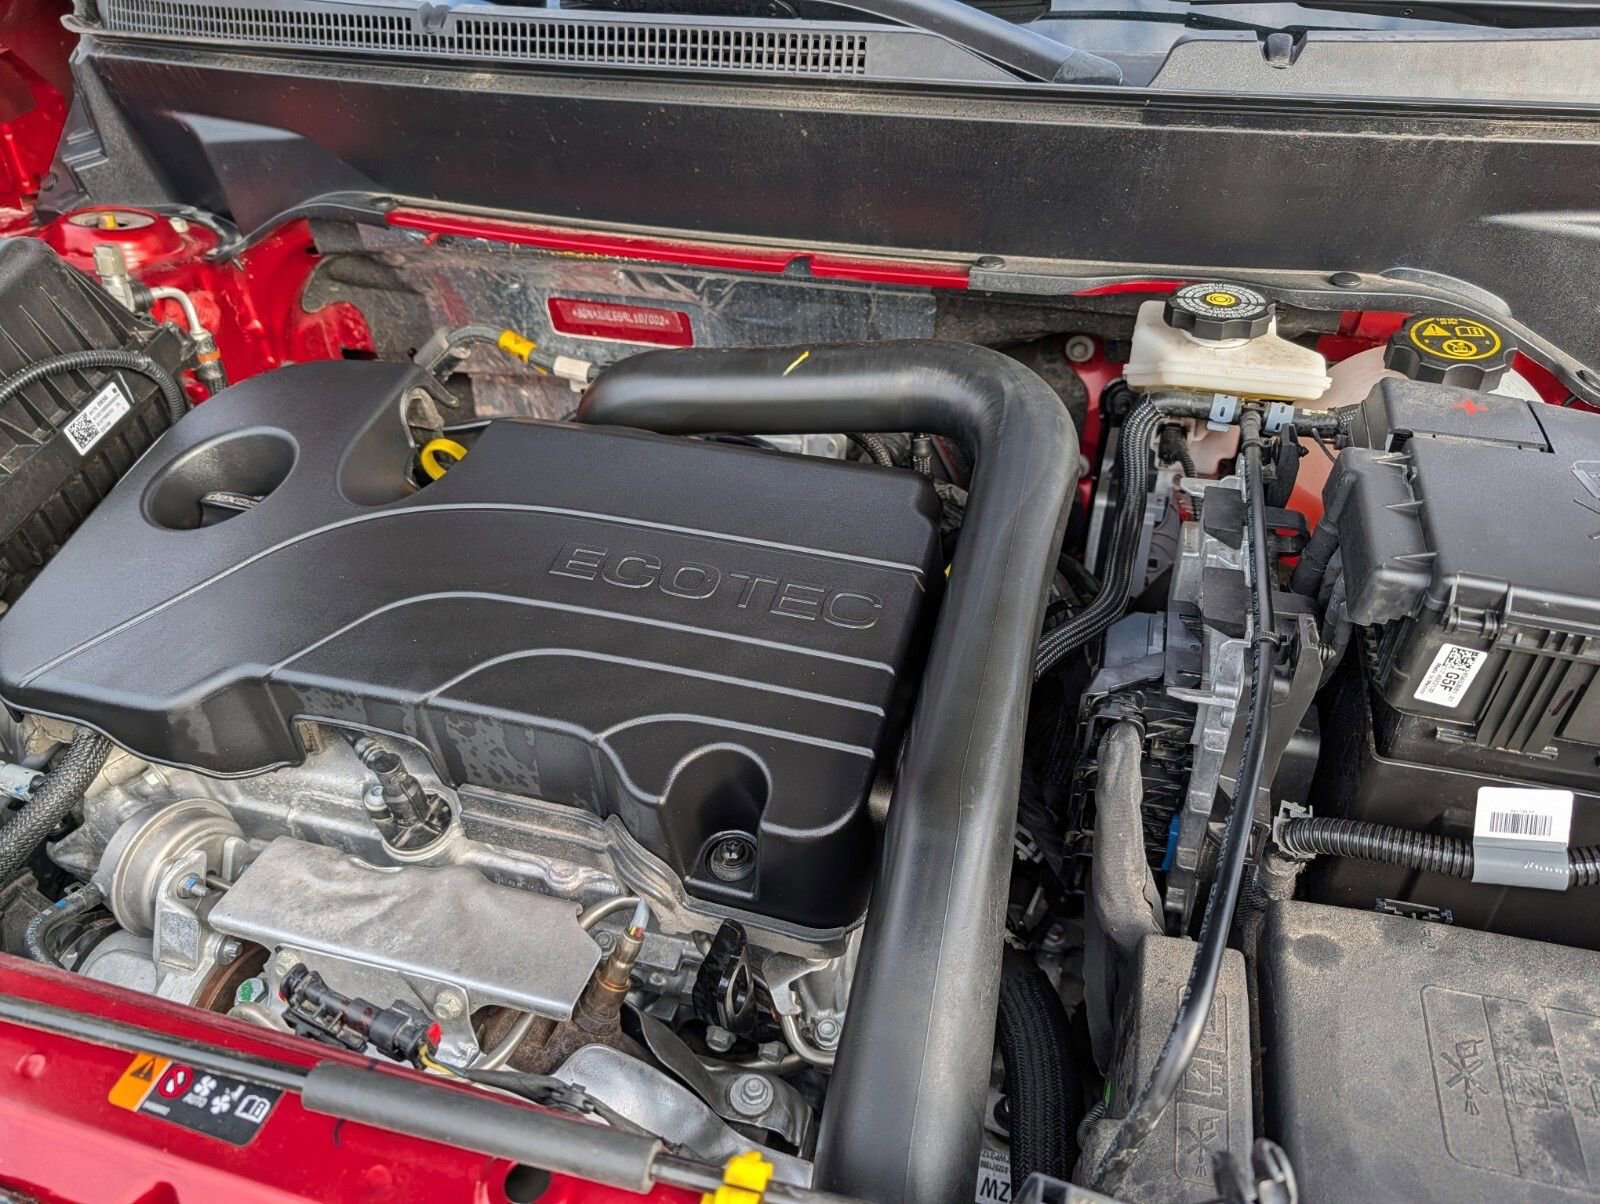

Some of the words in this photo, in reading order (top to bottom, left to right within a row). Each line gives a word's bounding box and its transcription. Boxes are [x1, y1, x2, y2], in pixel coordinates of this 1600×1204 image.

[549, 542, 883, 630] ECOTEC
[1440, 671, 1460, 692] G5F
[979, 1176, 1011, 1202] ZW
